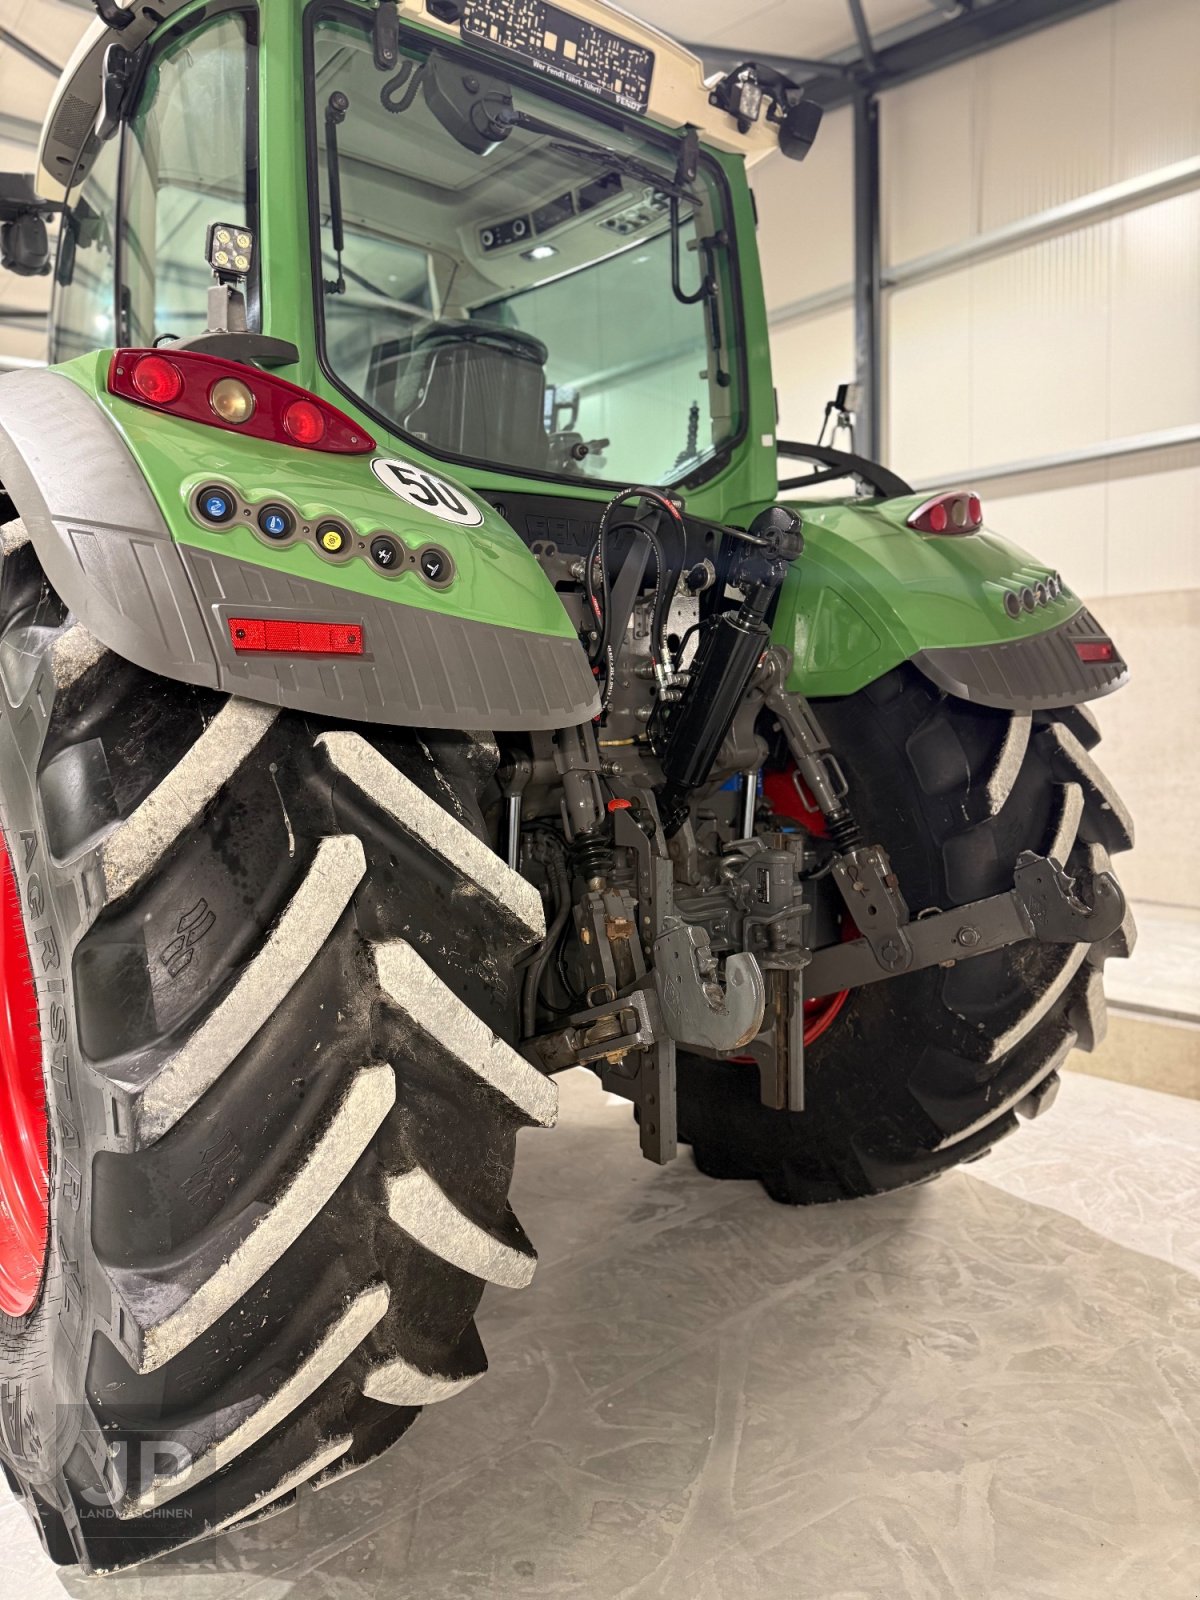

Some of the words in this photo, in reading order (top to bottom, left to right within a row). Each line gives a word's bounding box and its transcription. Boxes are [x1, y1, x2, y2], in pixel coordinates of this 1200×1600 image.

[533, 59, 546, 70] Wer
[546, 65, 565, 79] Fendt
[615, 94, 641, 112] FENDT
[385, 463, 468, 516] 50
[18, 829, 83, 1213] AGRISTAR
